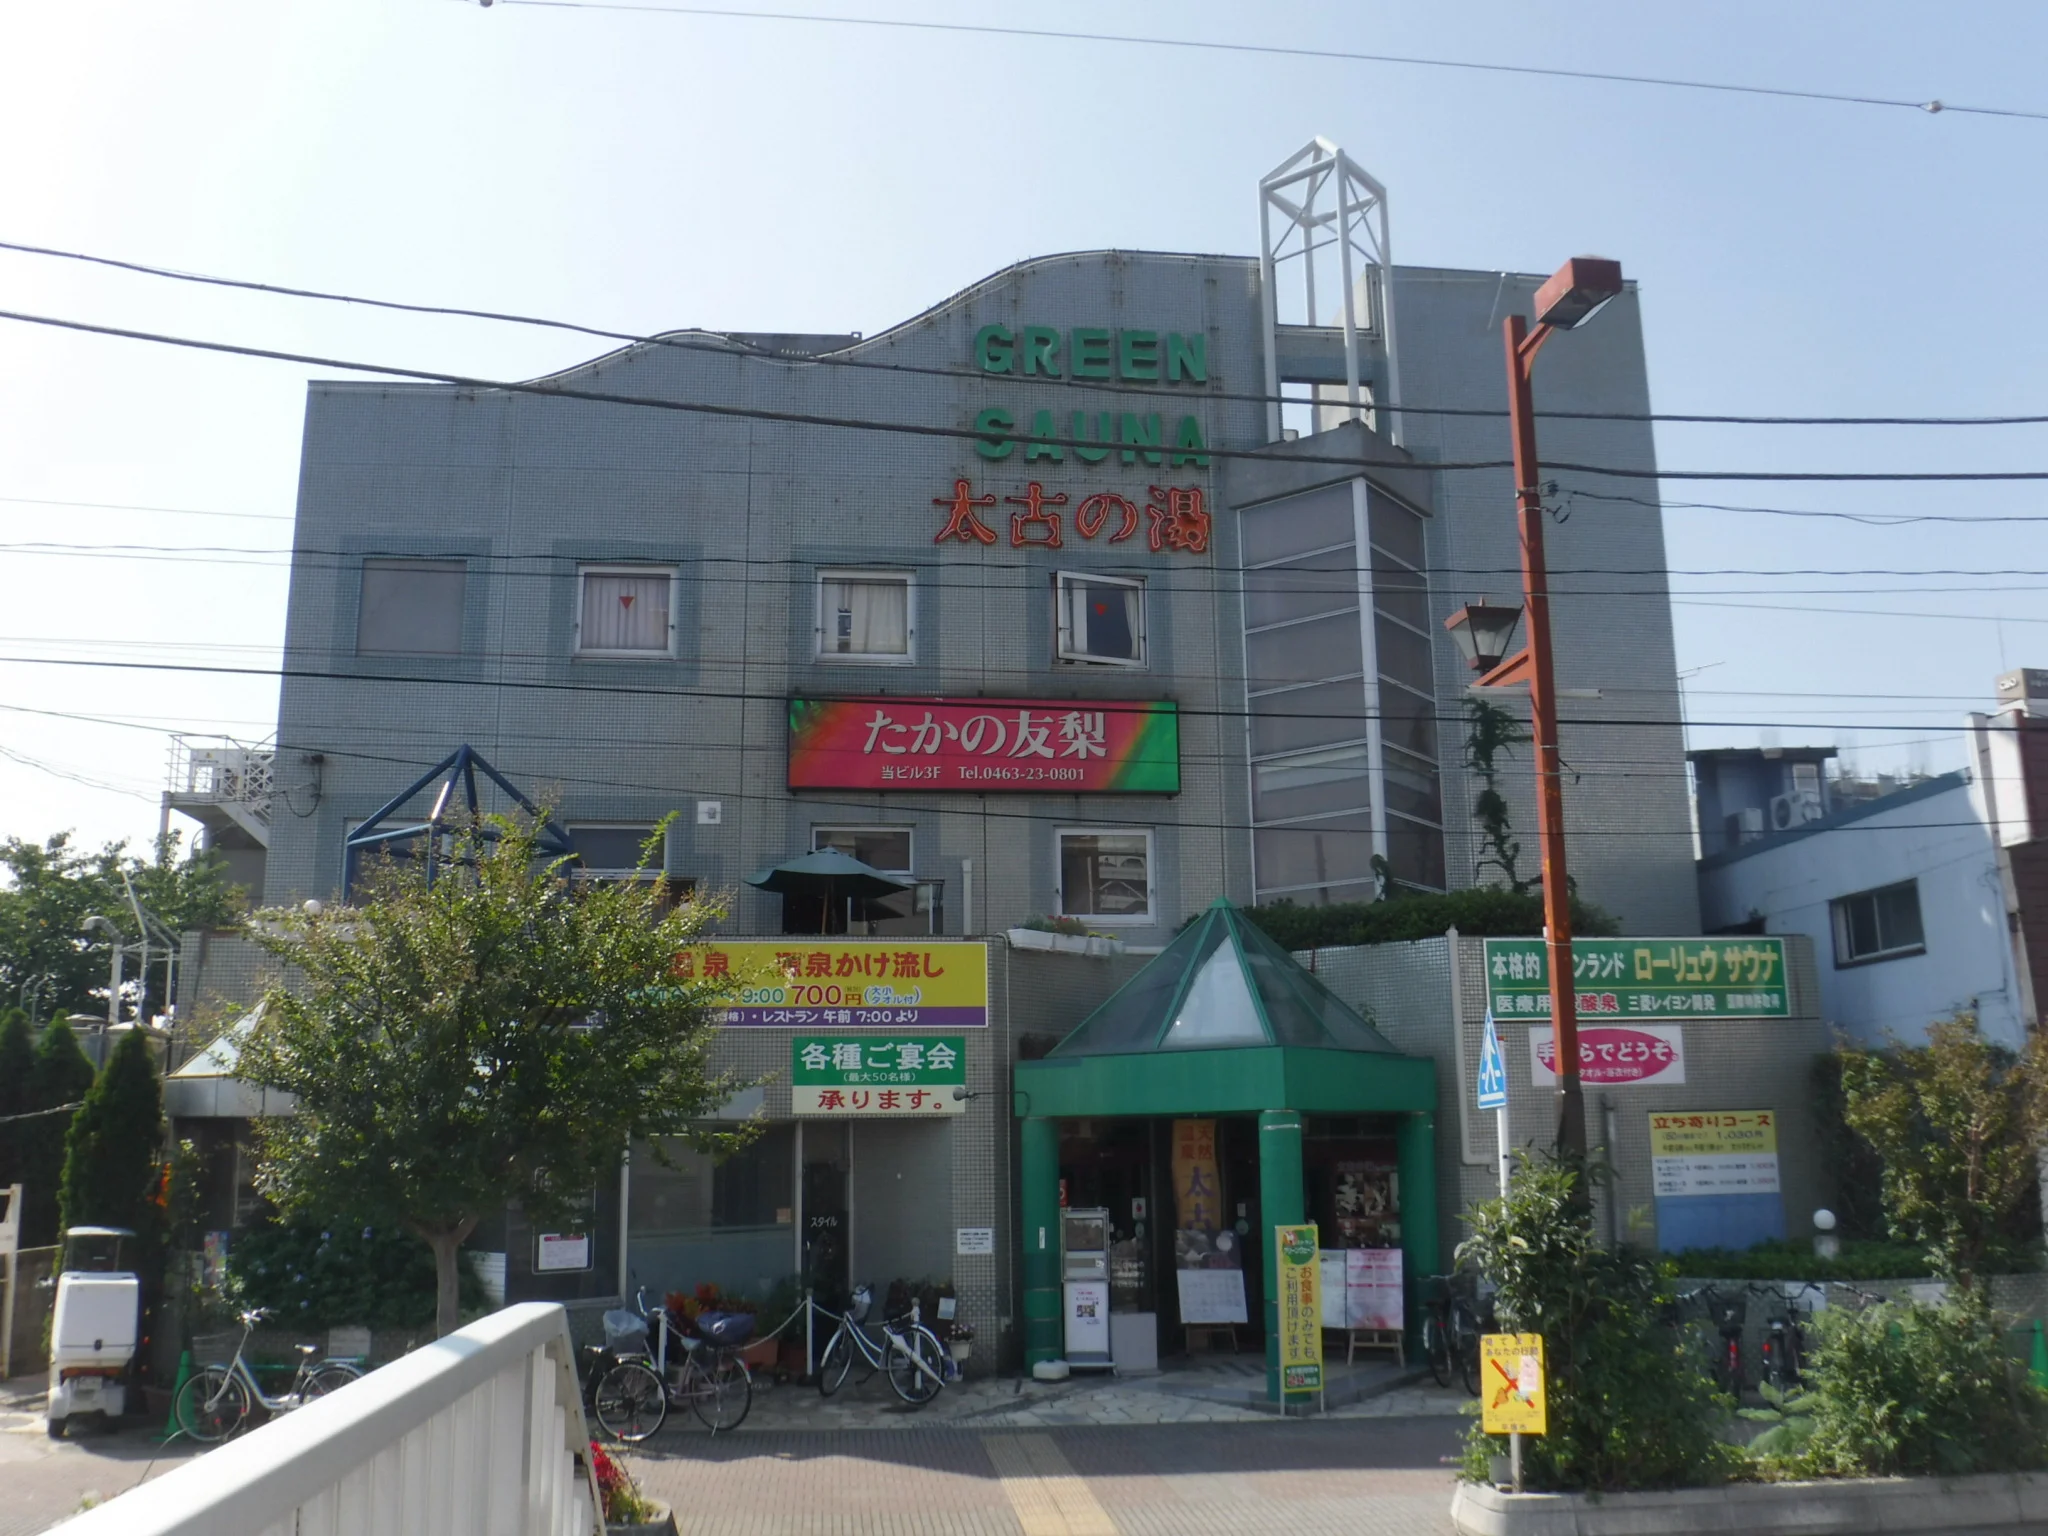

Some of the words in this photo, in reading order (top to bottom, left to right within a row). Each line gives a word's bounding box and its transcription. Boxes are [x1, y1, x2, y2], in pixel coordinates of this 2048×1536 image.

[974, 323, 1208, 385] GREEN
[975, 407, 1210, 467] SAUNA
[932, 478, 1212, 554] 太古の湯
[863, 709, 1108, 759] たかの友梨
[881, 766, 942, 780] 当ビル3F
[957, 766, 1085, 781] Tel.0463-23-0801
[1491, 952, 1541, 980] 本格的
[1572, 952, 1625, 979] ンランド
[1634, 944, 1718, 982] ローリュウ
[1723, 944, 1779, 982] サウナ
[823, 1010, 851, 1024] 午前
[856, 1010, 892, 1023] 7:00
[895, 1009, 919, 1024] より
[800, 1041, 957, 1071] 各種ご宴会
[1536, 1040, 1680, 1063] 手らでどうぞ。
[817, 1089, 943, 1111] 承ります。
[1653, 1114, 1771, 1130] 立ち寄りコース
